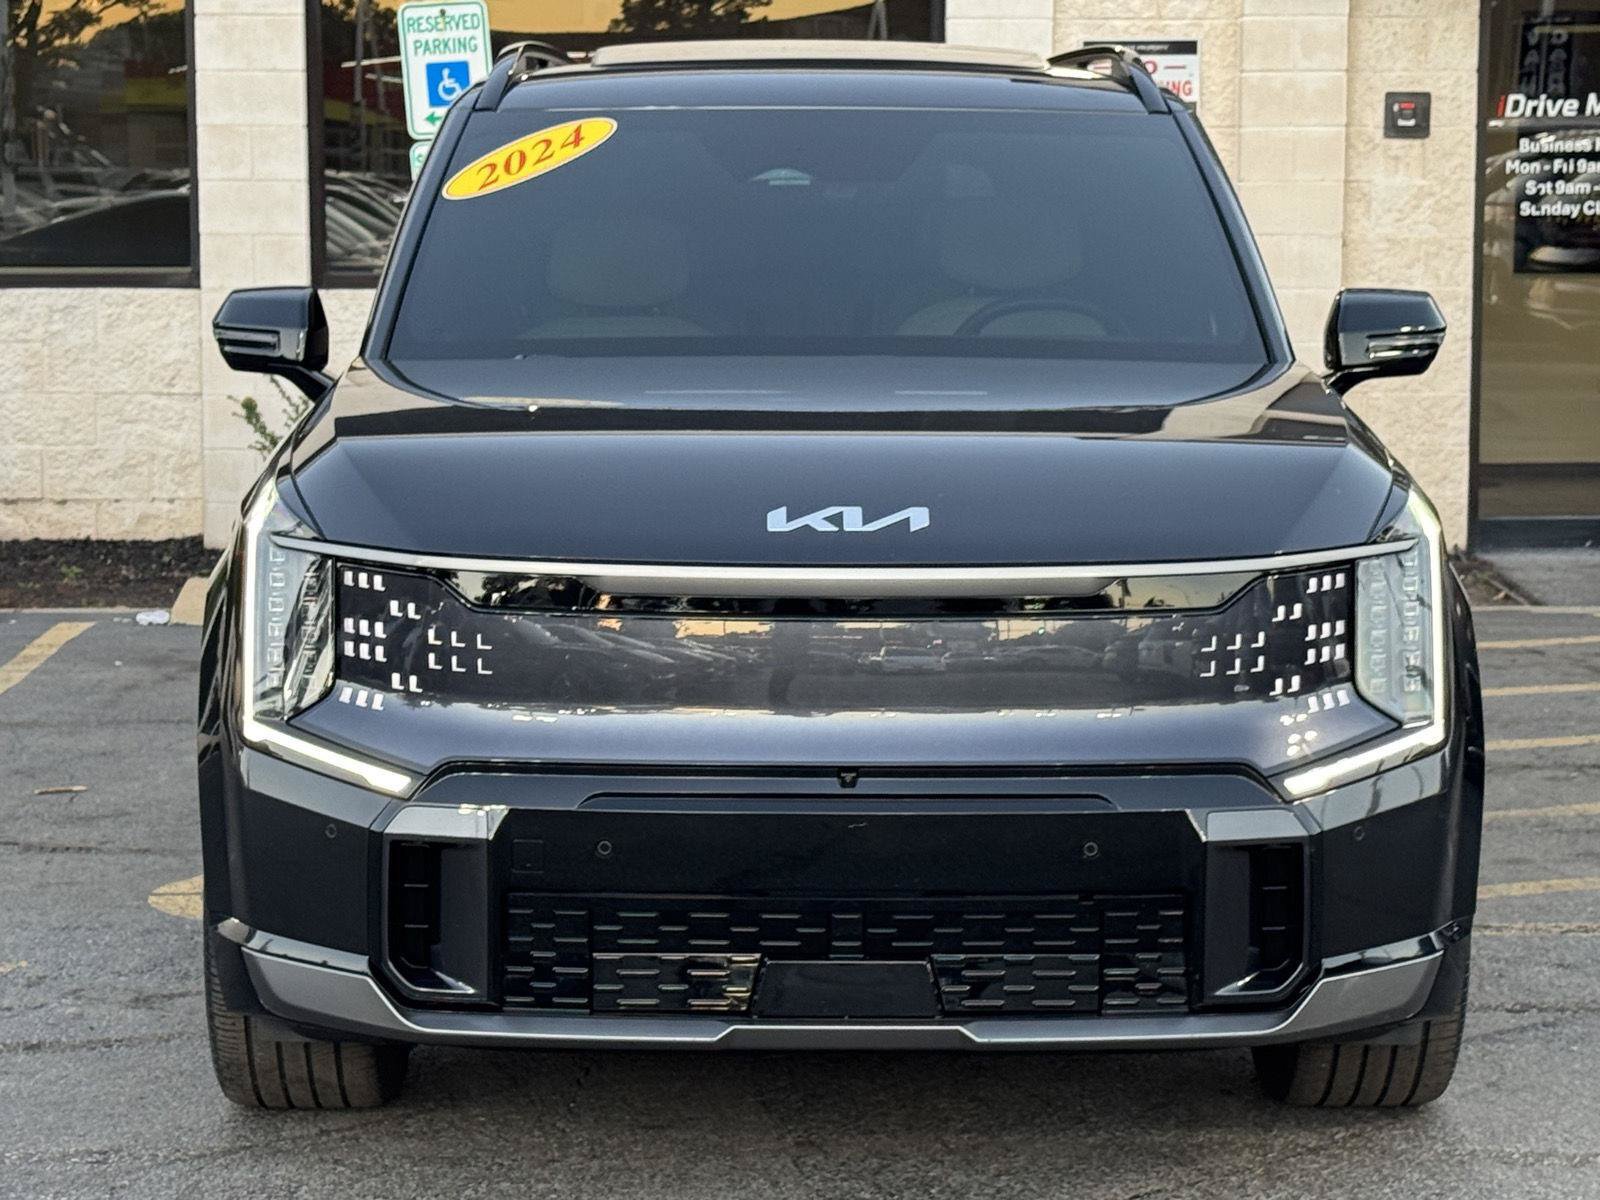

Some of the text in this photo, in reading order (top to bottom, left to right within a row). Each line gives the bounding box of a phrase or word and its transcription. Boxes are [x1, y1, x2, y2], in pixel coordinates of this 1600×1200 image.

[407, 13, 480, 33] RESERVED
[413, 36, 478, 56] PARKING
[1496, 93, 1580, 118] iDrive
[1518, 137, 1592, 153] Business
[476, 124, 585, 191] 2024
[1505, 159, 1541, 174] Mon
[1525, 179, 1553, 195] Sat
[1554, 180, 1591, 195] 9am
[1519, 200, 1581, 219] Sunday
[766, 505, 930, 532] KIA
